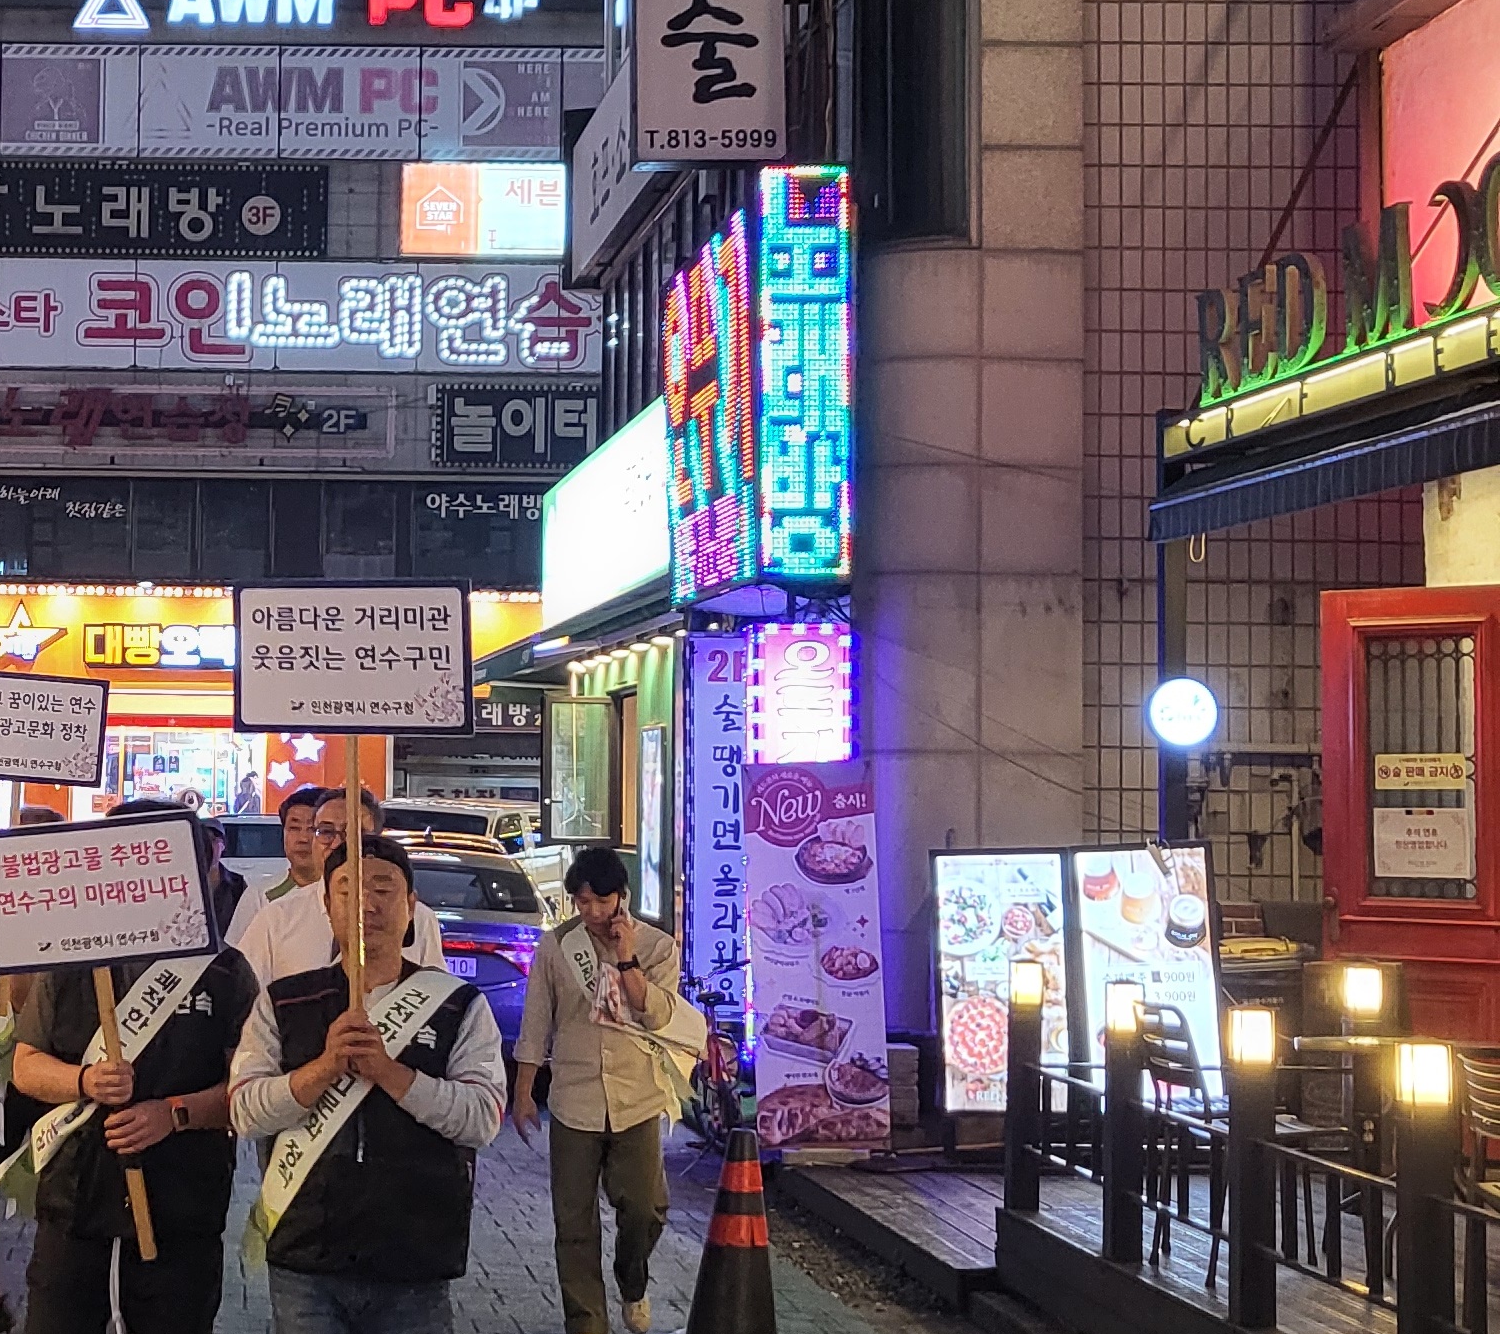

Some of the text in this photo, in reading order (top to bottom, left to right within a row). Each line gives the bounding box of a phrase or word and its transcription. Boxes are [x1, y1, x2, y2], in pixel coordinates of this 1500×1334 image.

[206, 66, 440, 115] AWM PC
[279, 119, 389, 139] Premium
[645, 129, 777, 150] T.813-5999
[504, 177, 562, 207] 세븐
[32, 181, 224, 242] 노래방
[247, 207, 276, 225] 3F
[83, 269, 604, 366] 코인노래연습
[1195, 253, 1328, 404] RED
[322, 409, 357, 434] 2F
[451, 396, 598, 453] 놀이터
[425, 492, 543, 519] 야수노래방
[251, 605, 451, 632] 아름다운 거리미관
[251, 644, 452, 672] 웃음짓는 연수구민
[7, 689, 65, 713] 꿈이있는
[68, 695, 98, 715] 연수
[474, 702, 531, 727] 래방
[712, 693, 744, 733] 술
[0, 716, 56, 739] 광고문화
[60, 720, 88, 743] 정착
[750, 788, 821, 832] New
[0, 838, 173, 880] 불법광고물 추방은
[85, 873, 190, 905] 미래입니다
[445, 958, 468, 974] 10
[121, 968, 182, 1036] 쾌적한
